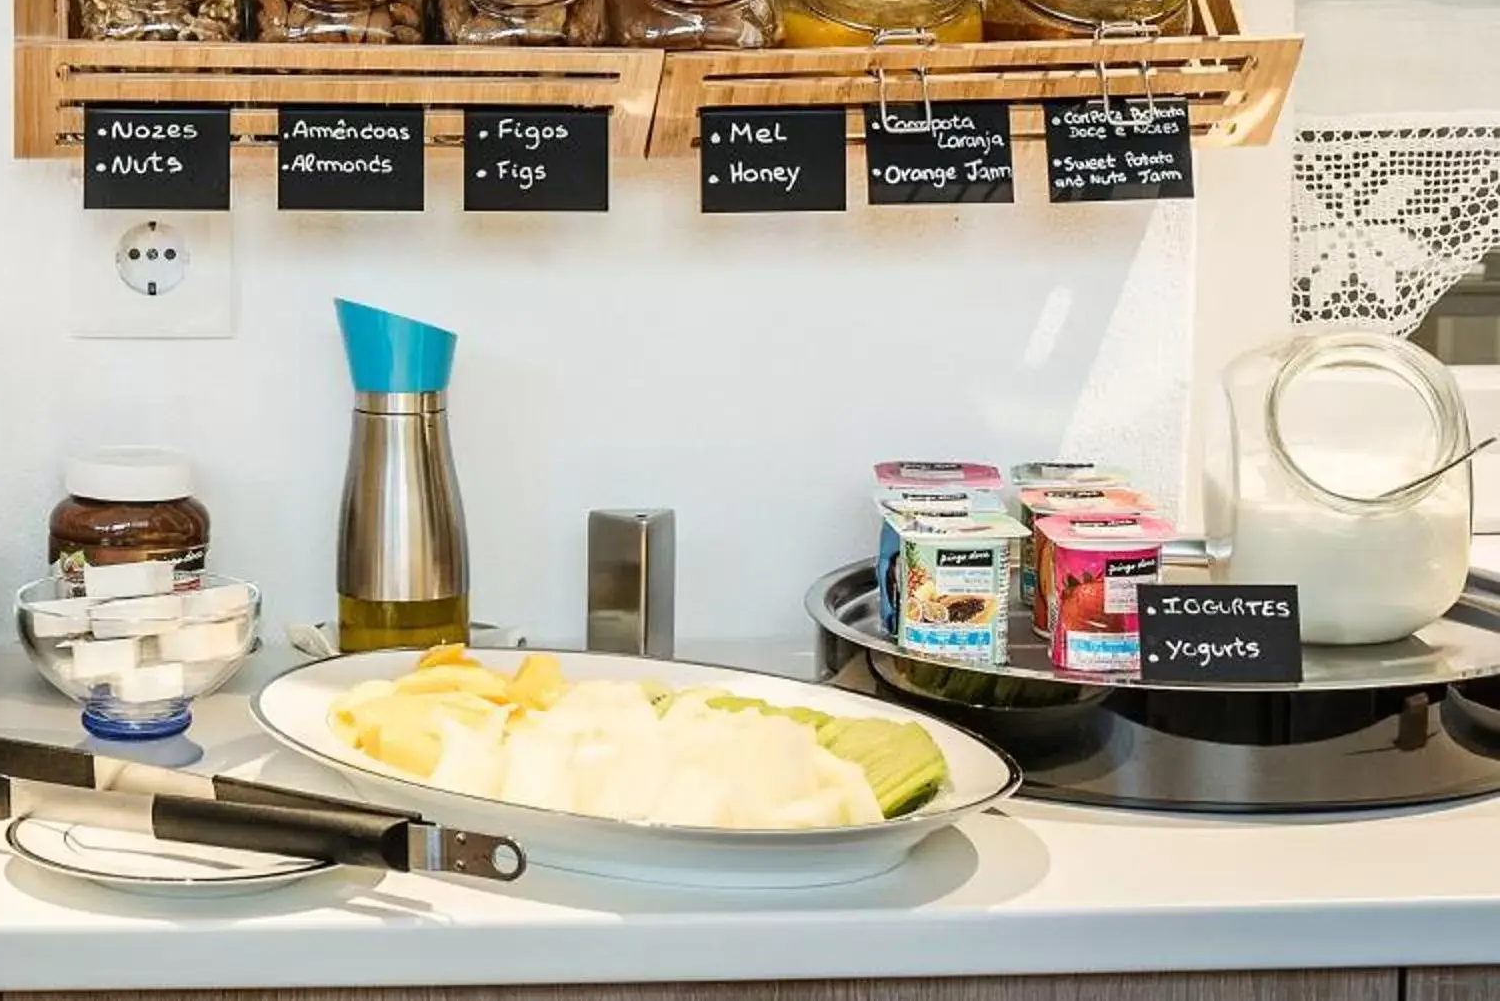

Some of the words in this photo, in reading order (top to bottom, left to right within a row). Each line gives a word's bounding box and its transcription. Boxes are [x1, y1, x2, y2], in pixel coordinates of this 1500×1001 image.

[111, 120, 198, 140] Nozes
[292, 119, 411, 141] Amêndoas
[498, 118, 569, 150] Figos
[938, 130, 1005, 155] Laranja
[111, 151, 183, 175] Nuts
[291, 152, 393, 173] Almonds
[496, 160, 547, 189] Figs
[729, 160, 801, 192] Honey
[885, 165, 957, 188] Orange
[1162, 596, 1291, 617] IOGURTES
